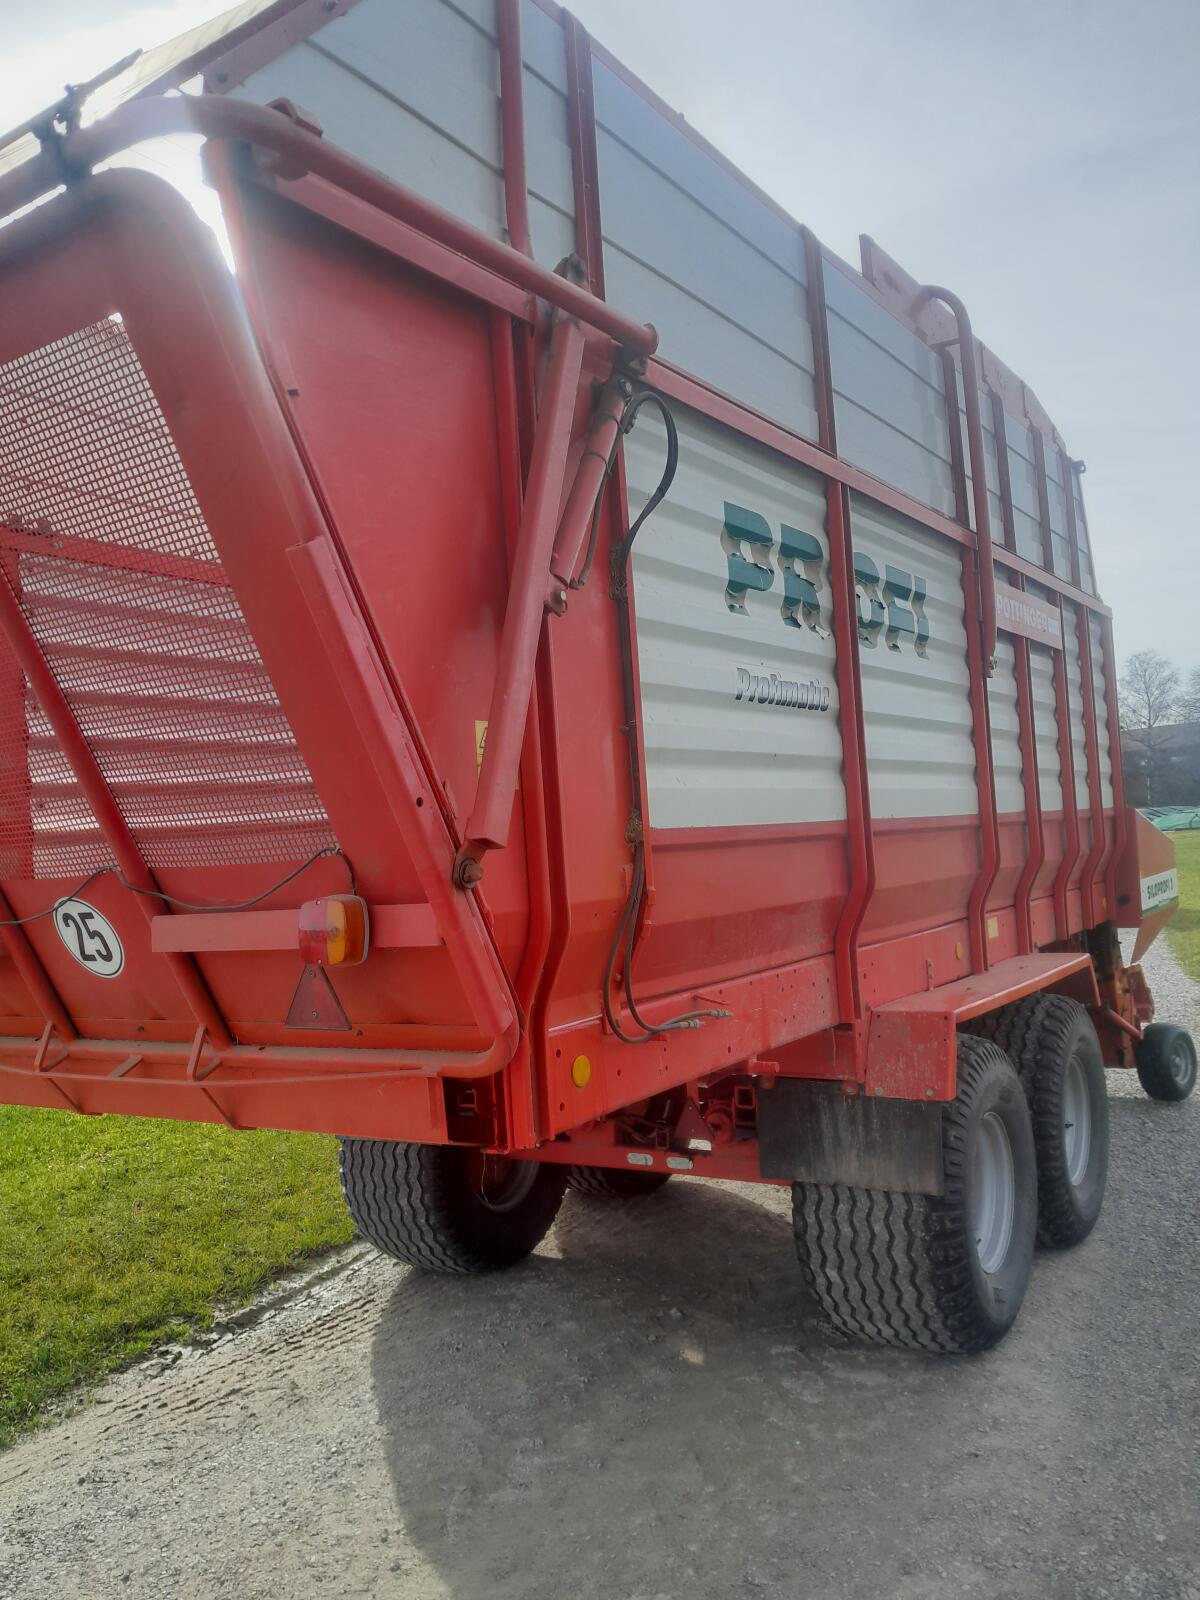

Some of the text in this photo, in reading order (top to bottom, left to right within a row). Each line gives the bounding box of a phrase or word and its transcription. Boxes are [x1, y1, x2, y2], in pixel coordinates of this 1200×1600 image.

[720, 501, 929, 659] PROFI
[735, 667, 830, 712] Profimatic
[62, 912, 114, 963] 25
